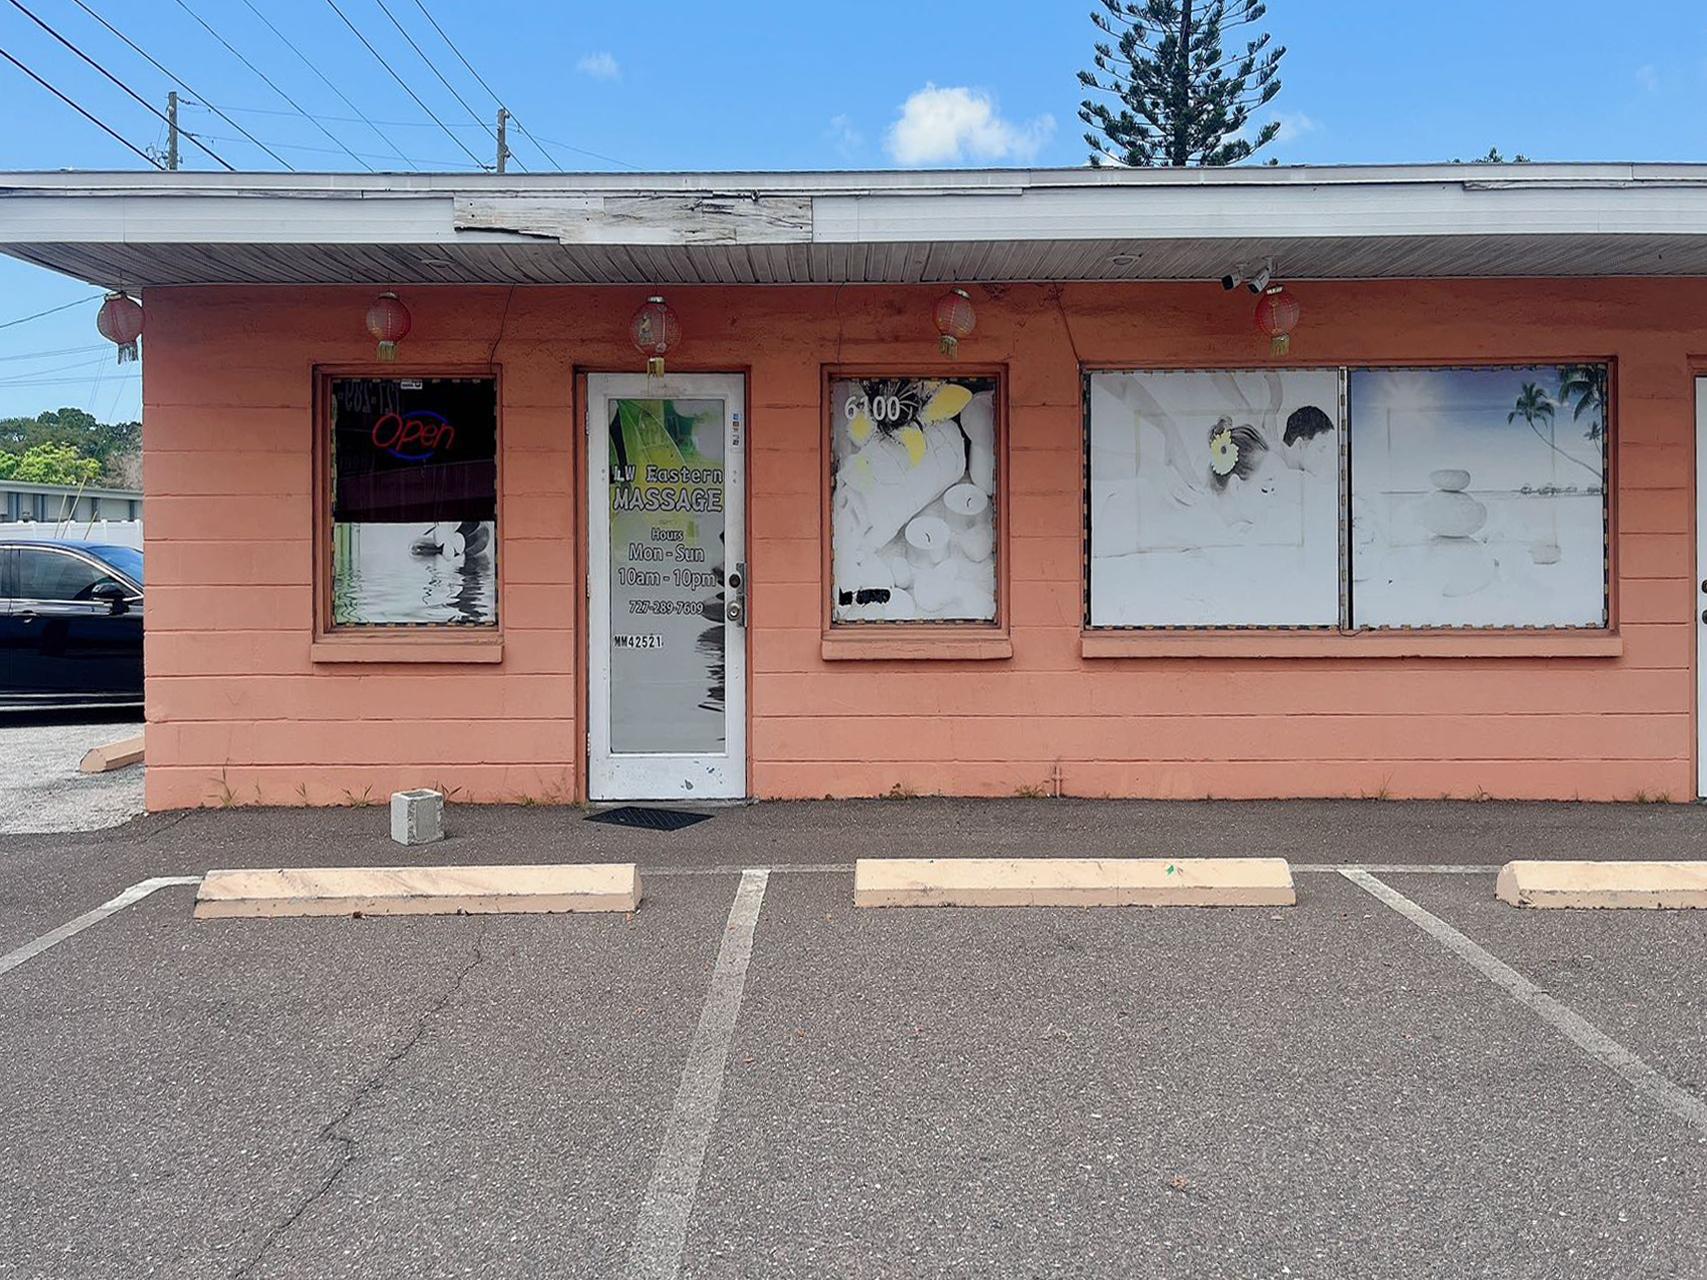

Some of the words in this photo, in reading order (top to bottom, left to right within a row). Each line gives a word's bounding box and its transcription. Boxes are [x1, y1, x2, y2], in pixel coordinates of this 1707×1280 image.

[844, 395, 900, 421] 6100
[372, 412, 456, 450] Open
[646, 464, 723, 483] Eastern
[613, 487, 723, 512] MASSAGE
[651, 527, 684, 541] Hours
[628, 543, 663, 561] Mon
[674, 545, 705, 562] Sun
[618, 567, 661, 586] 10am
[673, 569, 717, 591] 10pm
[628, 600, 705, 615] 727-289-7609
